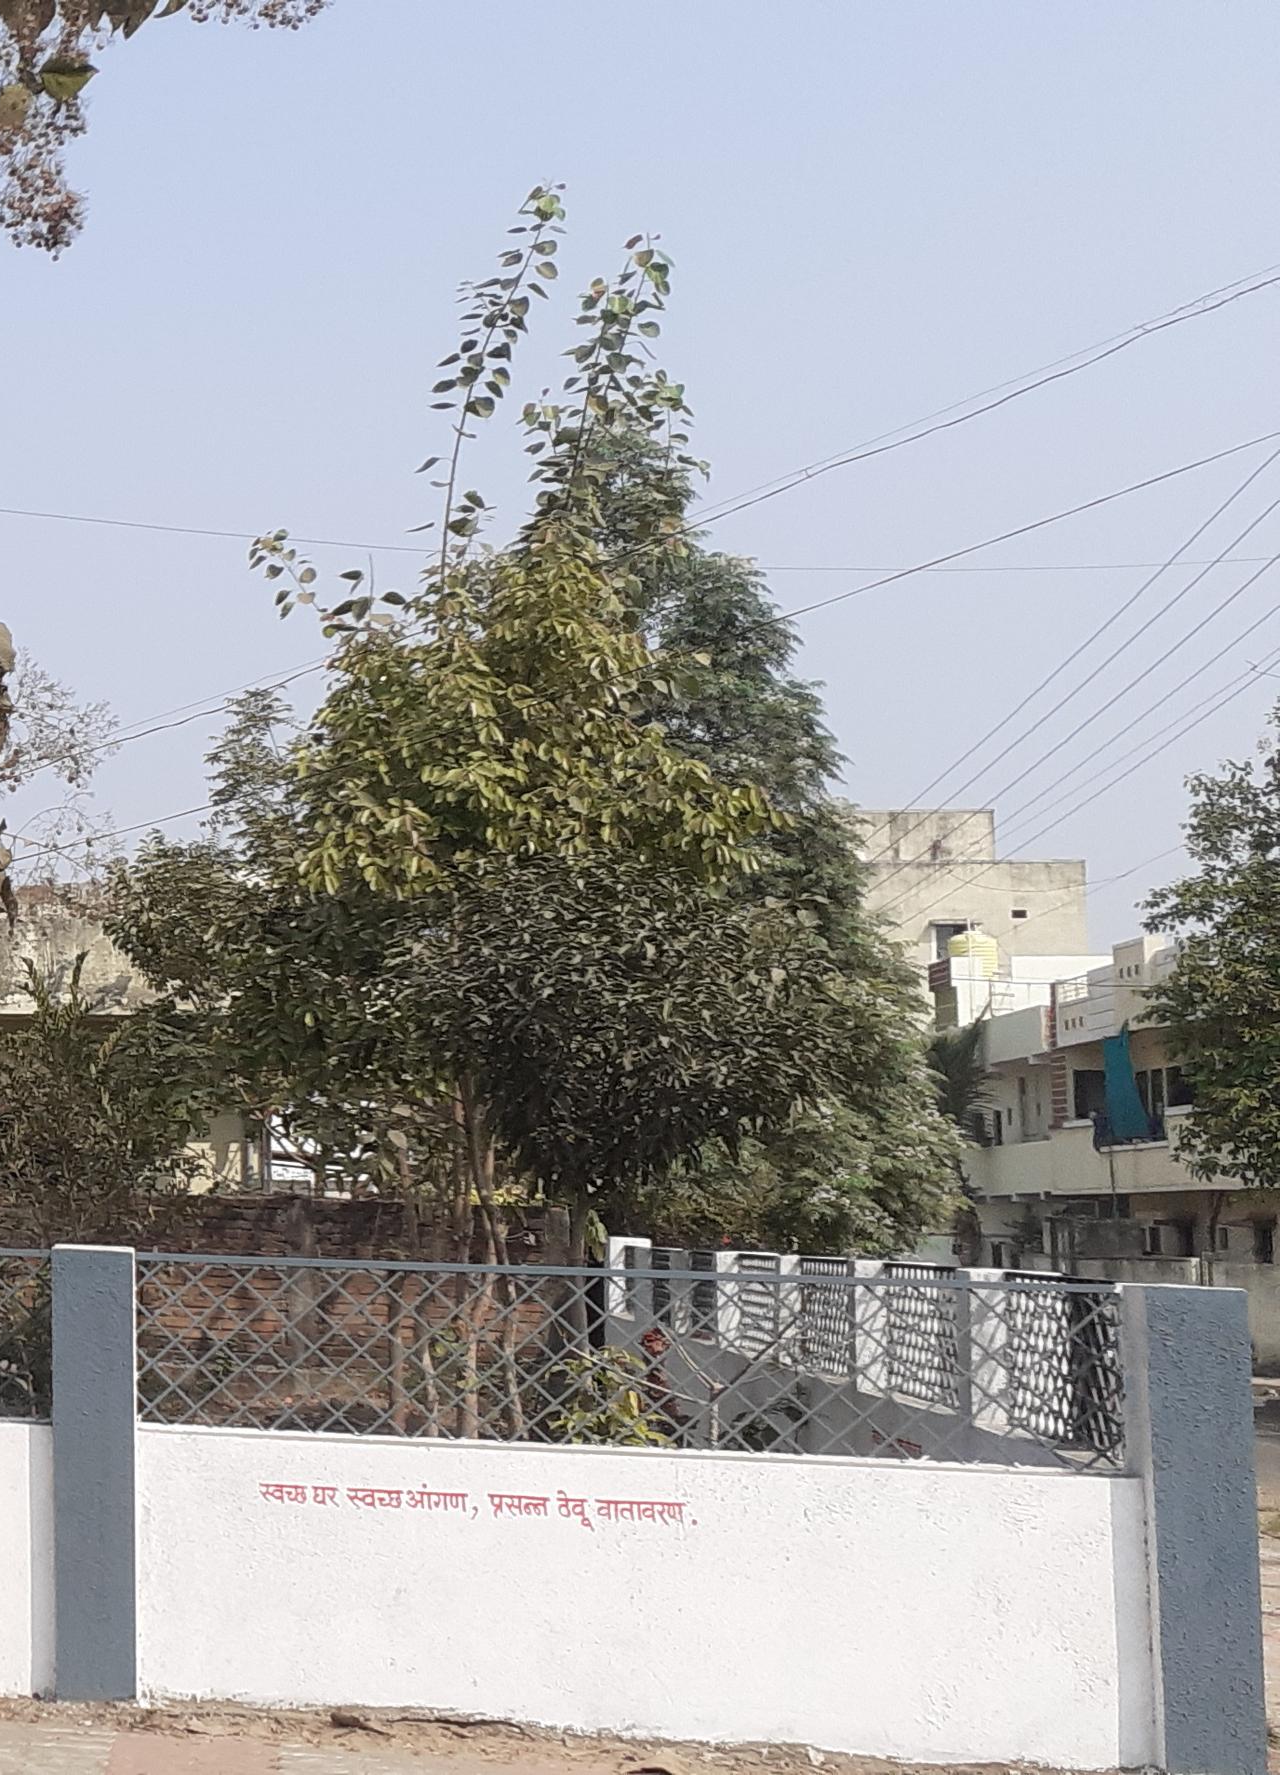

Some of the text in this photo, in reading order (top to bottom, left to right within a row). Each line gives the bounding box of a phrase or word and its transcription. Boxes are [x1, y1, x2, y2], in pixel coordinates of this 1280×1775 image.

[259, 1483, 307, 1504] स्वच्छ
[312, 1486, 339, 1507] घर
[346, 1488, 403, 1509] स्वच्छ
[488, 1493, 550, 1517] प्रसन्न
